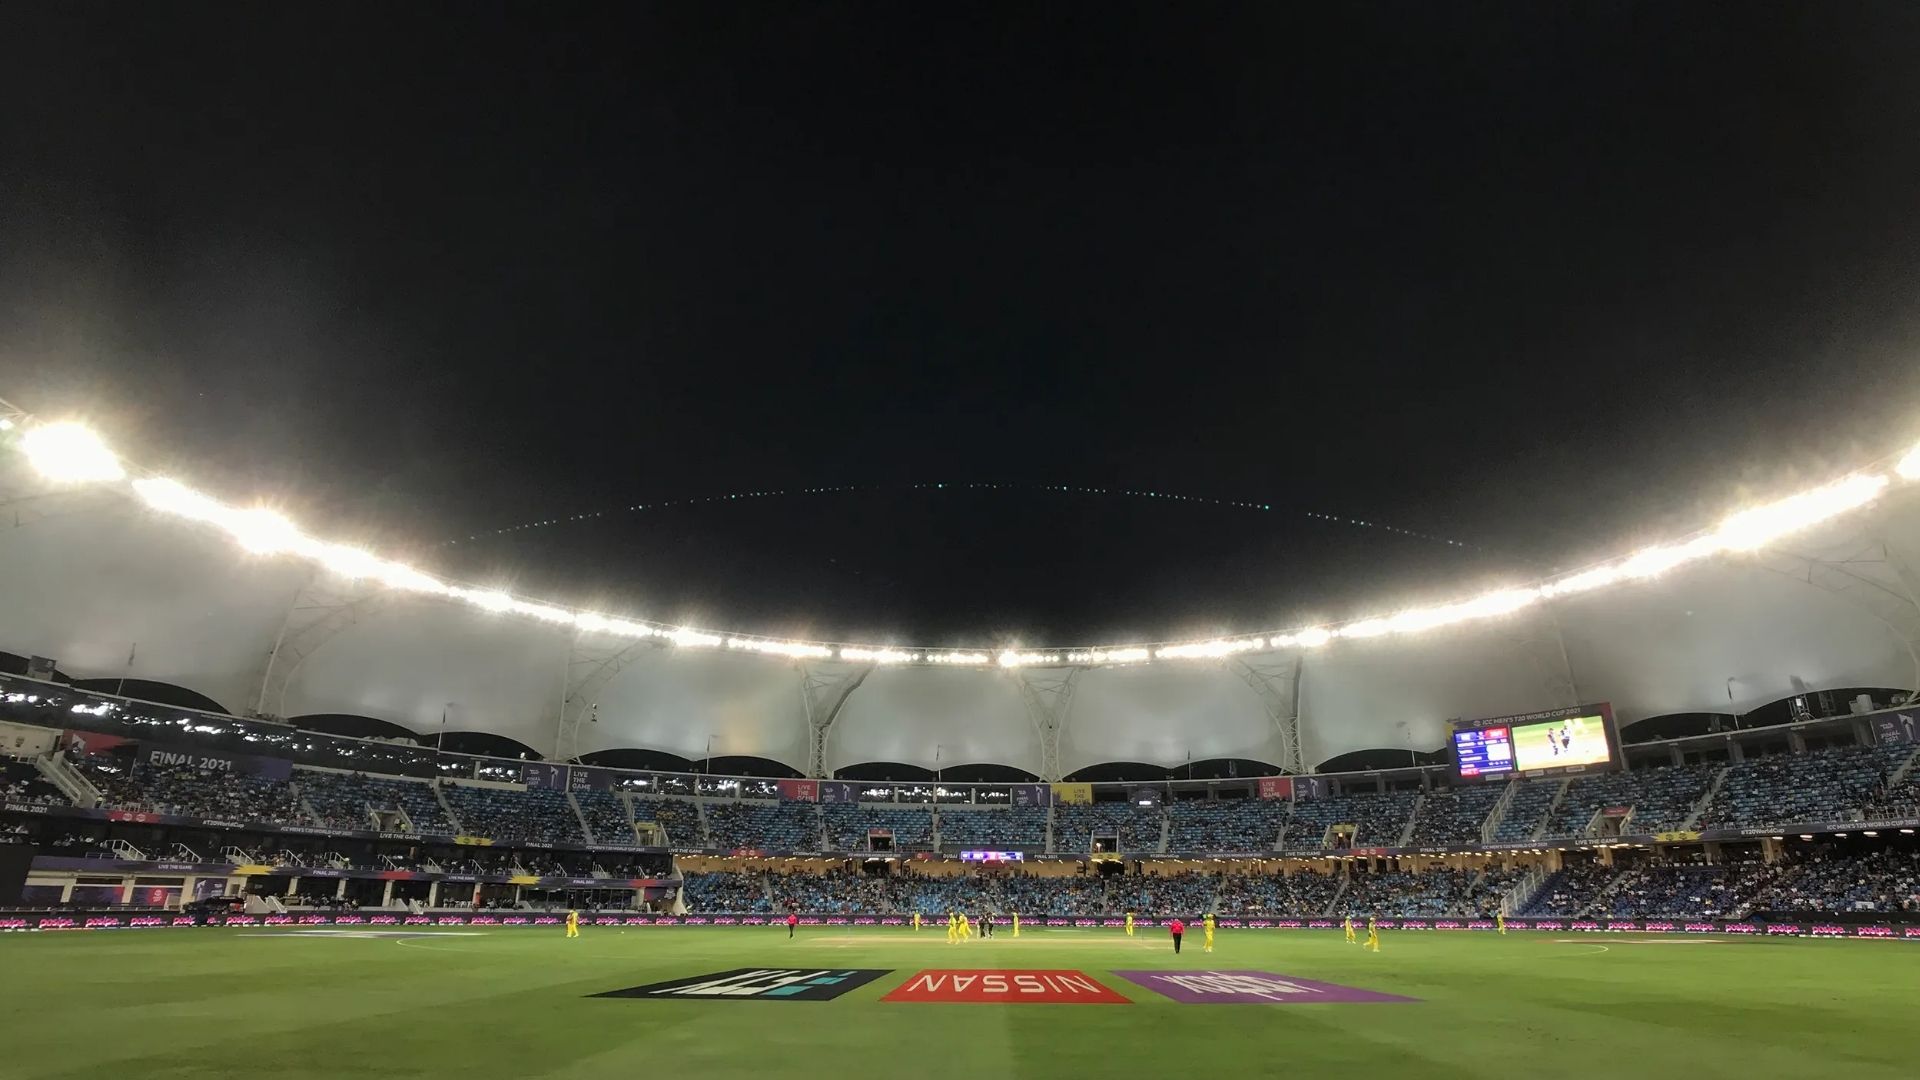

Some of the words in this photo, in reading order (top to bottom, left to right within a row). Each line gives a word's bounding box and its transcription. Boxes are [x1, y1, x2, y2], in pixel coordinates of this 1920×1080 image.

[1526, 712, 1551, 721] WORLD
[1551, 709, 1566, 718] CUP
[1566, 707, 1581, 715] 2021
[150, 750, 195, 767] FINAL
[199, 757, 232, 771] 2021
[573, 770, 589, 778] LIVE
[572, 783, 591, 791] GAME
[4, 803, 29, 812] FINAL
[30, 805, 48, 814] 2021
[906, 974, 1101, 993] NISSAN
